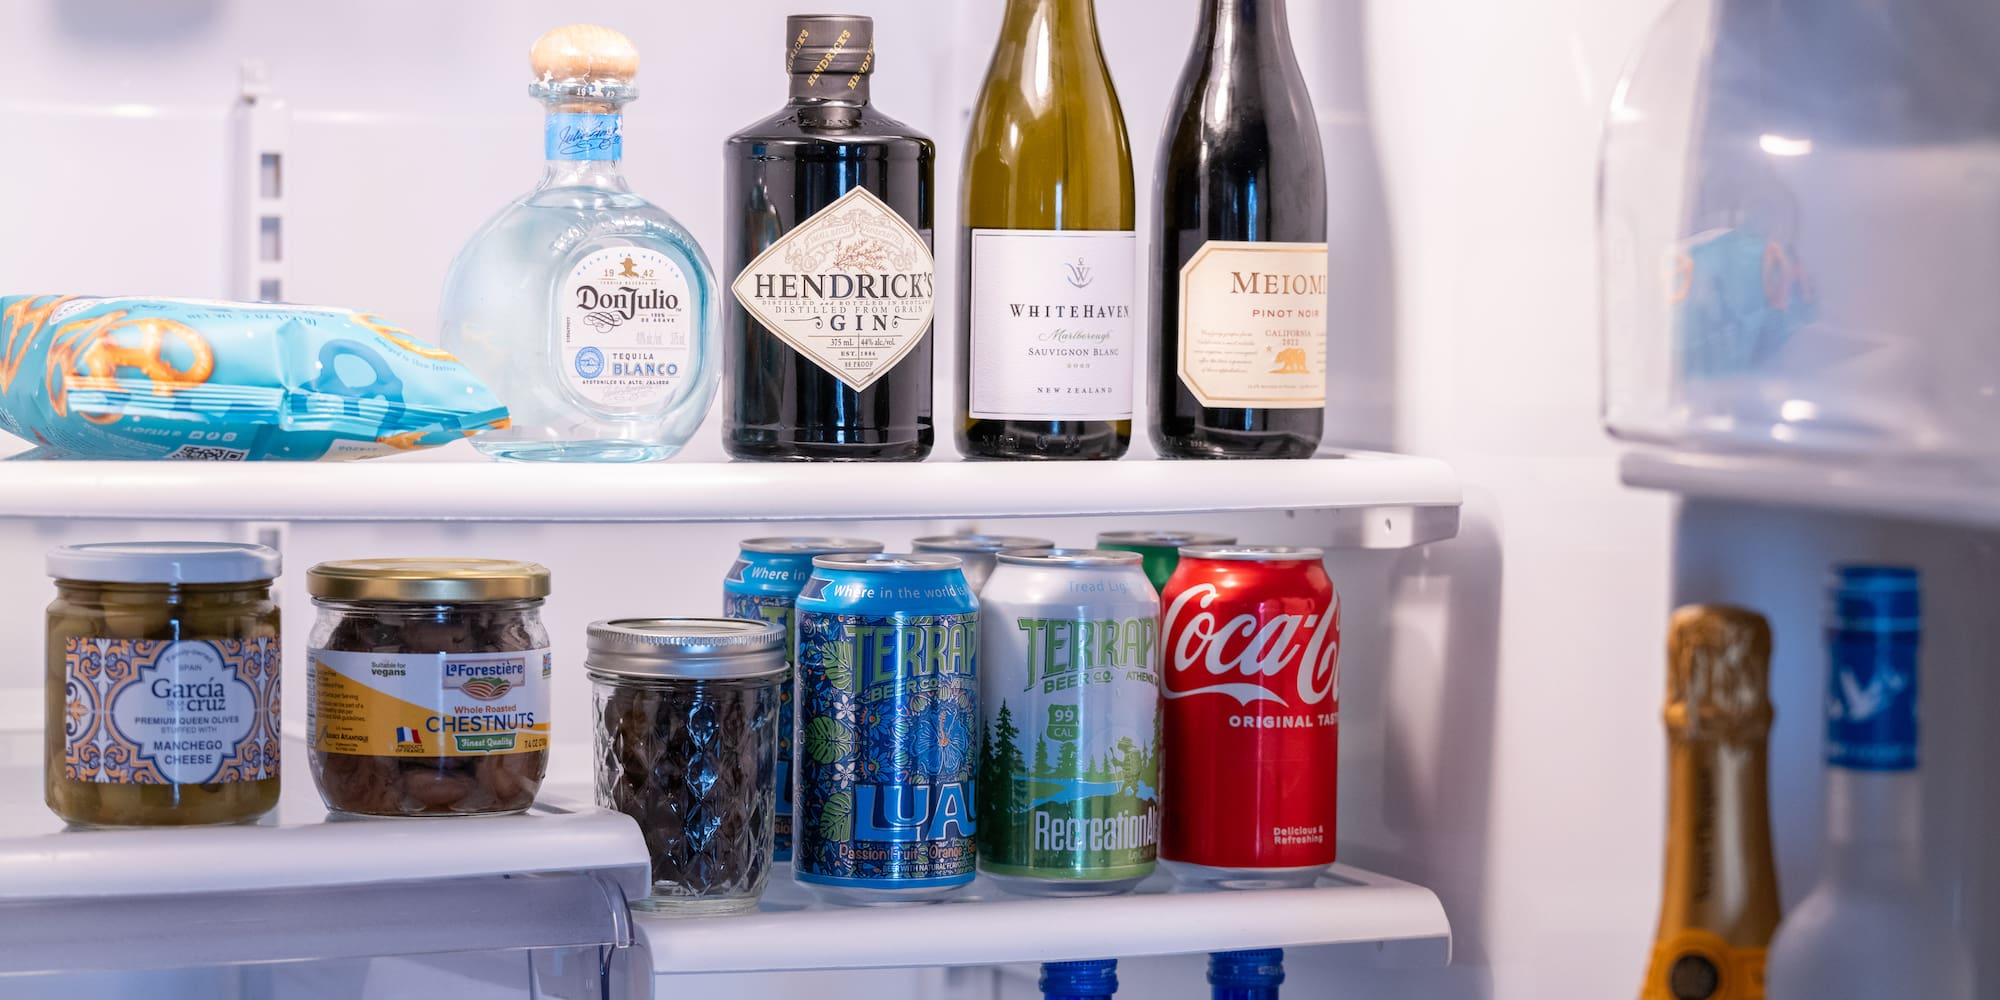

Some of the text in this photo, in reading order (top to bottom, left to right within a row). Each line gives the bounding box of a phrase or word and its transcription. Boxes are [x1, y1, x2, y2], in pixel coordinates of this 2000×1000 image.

[808, 30, 851, 86] HENDRICK'S
[604, 269, 654, 277] 19 42
[754, 272, 933, 298] HENDRICK'S
[894, 305, 924, 313] GRAIN
[1252, 310, 1319, 318] PINOT NOIR
[830, 314, 888, 331] GIN
[1028, 348, 1089, 356] SAUVIGNON
[613, 363, 678, 376] BLANCO
[752, 566, 806, 580] Where in
[834, 585, 875, 598] Where
[880, 586, 893, 598] in
[898, 586, 920, 598] the
[924, 584, 956, 598] world
[371, 668, 406, 678] vegans
[152, 676, 225, 698] García
[1044, 674, 1090, 694] BEER
[871, 682, 917, 702] BEER
[187, 698, 226, 712] cruz
[454, 704, 517, 714] Whole Roasted
[134, 716, 240, 725] PREMIUM QUEEN OLIVES
[1054, 708, 1074, 722] 99
[1228, 714, 1314, 728] ORIGINAL
[426, 712, 534, 732] CHESTNUTS
[1054, 727, 1073, 738] CAL
[154, 740, 222, 750] MANCHEGO
[462, 736, 513, 746] Finest Quality
[164, 754, 212, 764] CHEESE
[1273, 825, 1324, 836] Delicious &
[1274, 834, 1324, 844] Refreshing
[839, 844, 888, 860] Passion
[890, 844, 918, 860] Fruit
[929, 844, 963, 861] Orange
